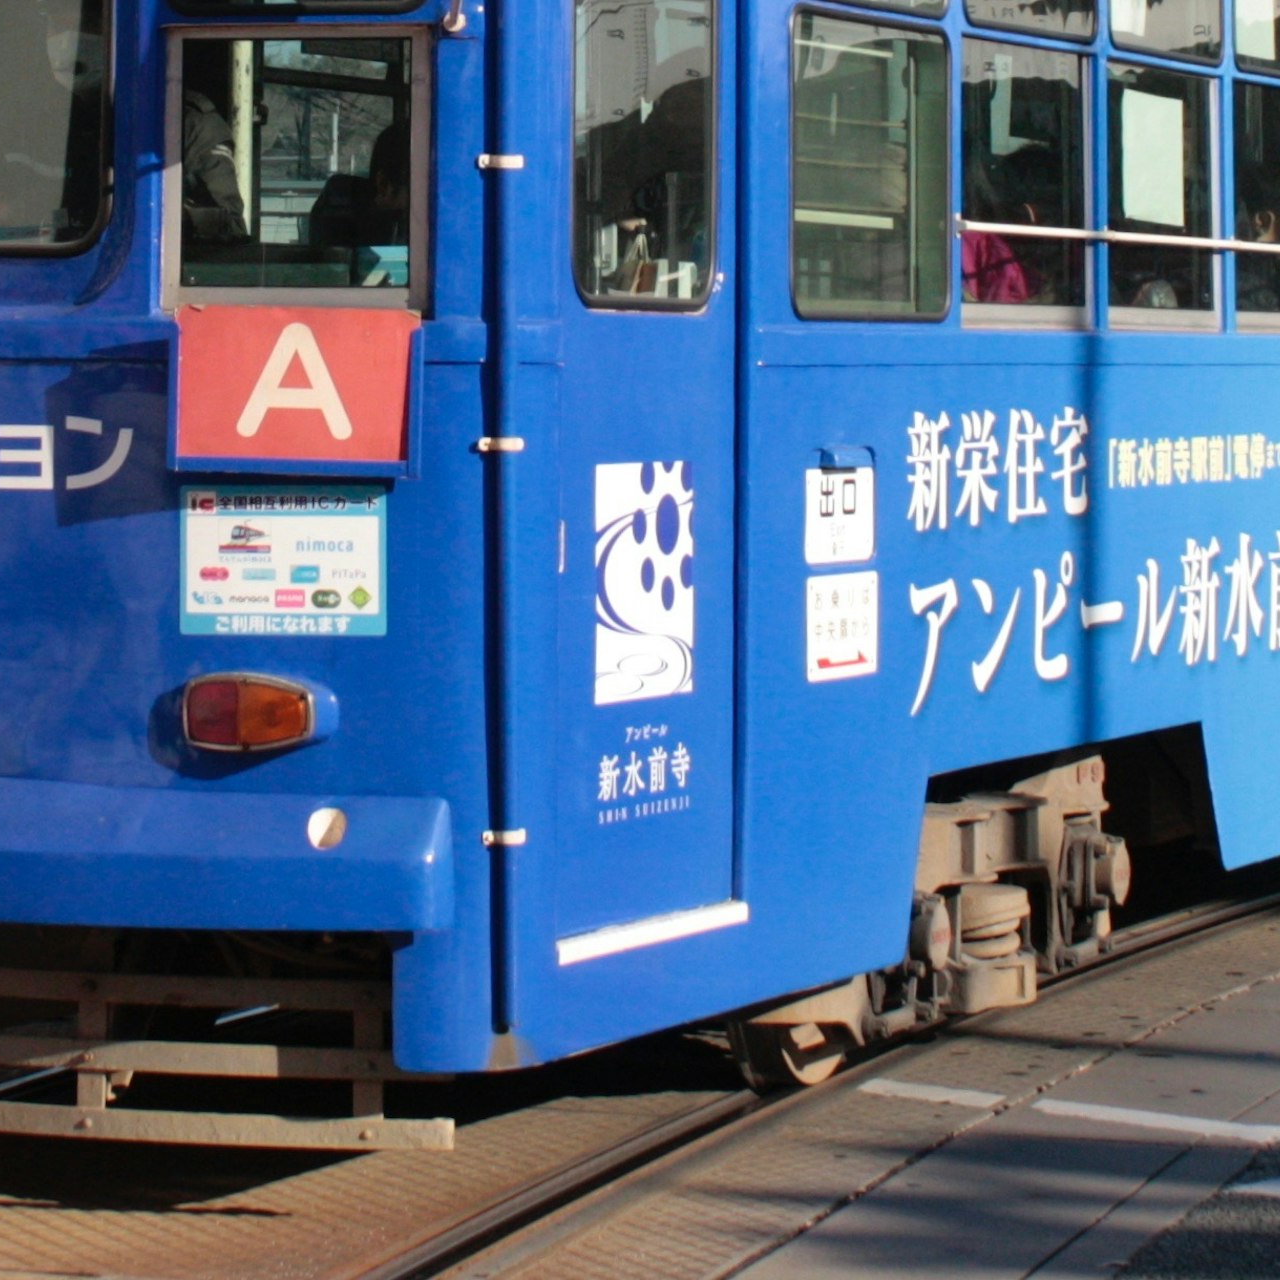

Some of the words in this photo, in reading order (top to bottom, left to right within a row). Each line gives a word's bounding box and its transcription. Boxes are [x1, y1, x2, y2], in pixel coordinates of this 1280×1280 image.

[236, 321, 353, 441] A
[906, 405, 1089, 532] 新栄住宅
[819, 476, 857, 517] 出口
[295, 538, 355, 552] nimoca
[214, 615, 351, 633] ご利用になれます
[624, 723, 669, 743] アンピール
[597, 741, 691, 801] 新水前寺
